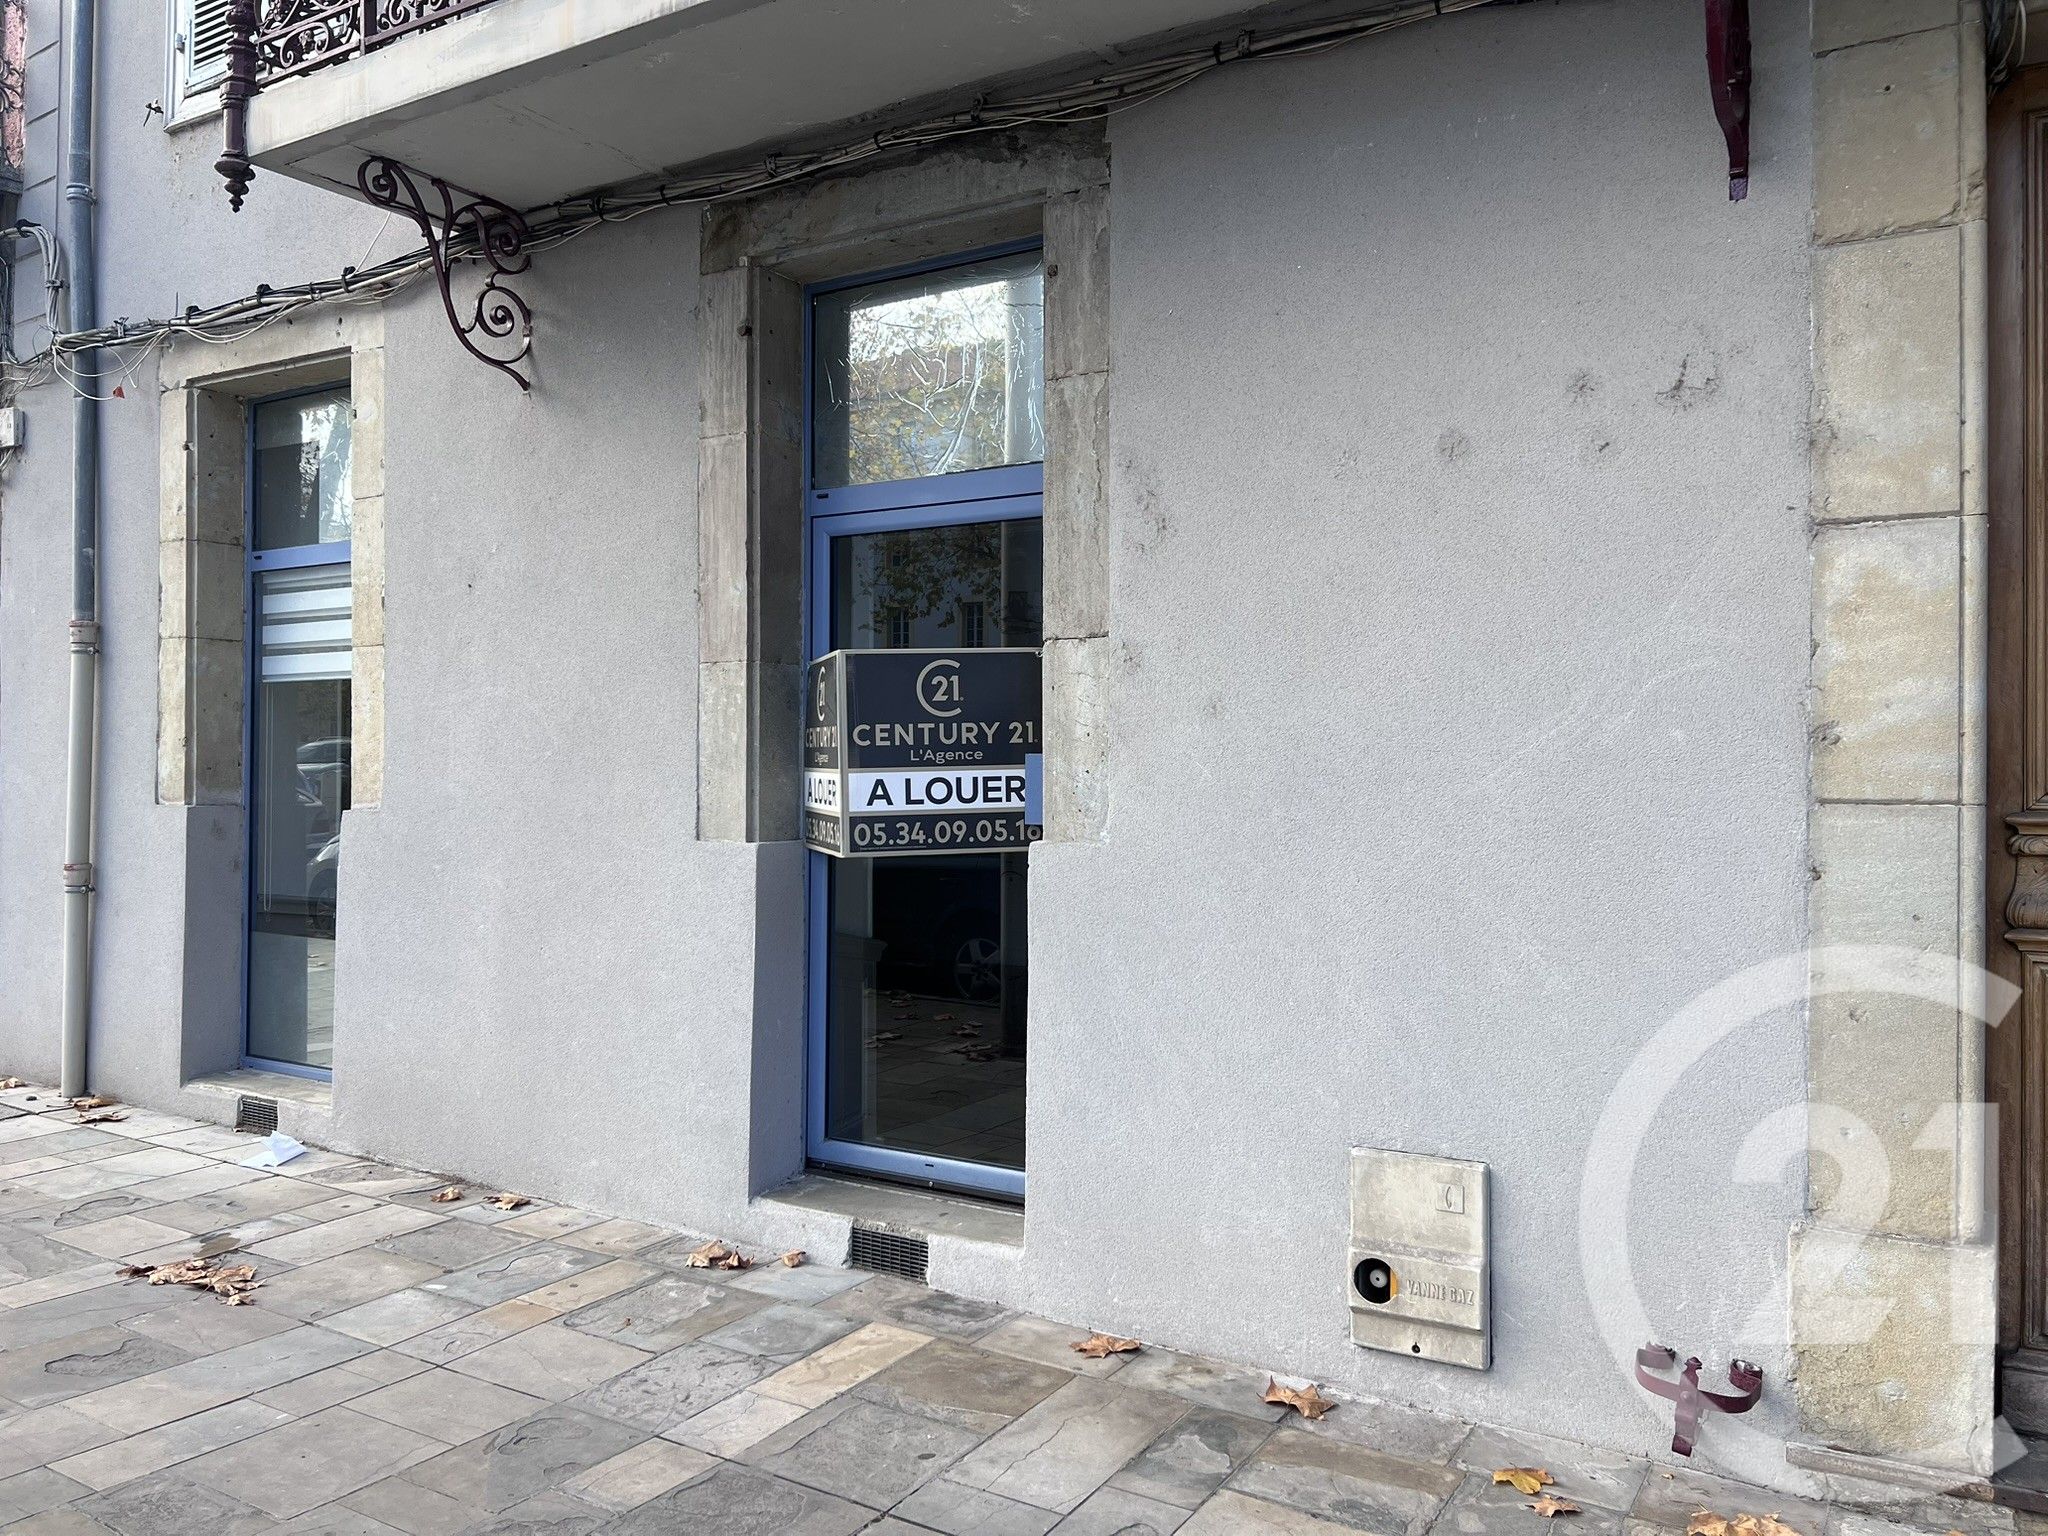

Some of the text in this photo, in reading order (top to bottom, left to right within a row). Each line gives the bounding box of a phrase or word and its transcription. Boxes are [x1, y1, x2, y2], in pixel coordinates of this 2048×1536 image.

[852, 722, 1000, 746] CENTURY
[910, 749, 984, 764] L'Agence
[866, 776, 1026, 806] A LOUER
[1406, 1279, 1475, 1305] VANNE GAZ
